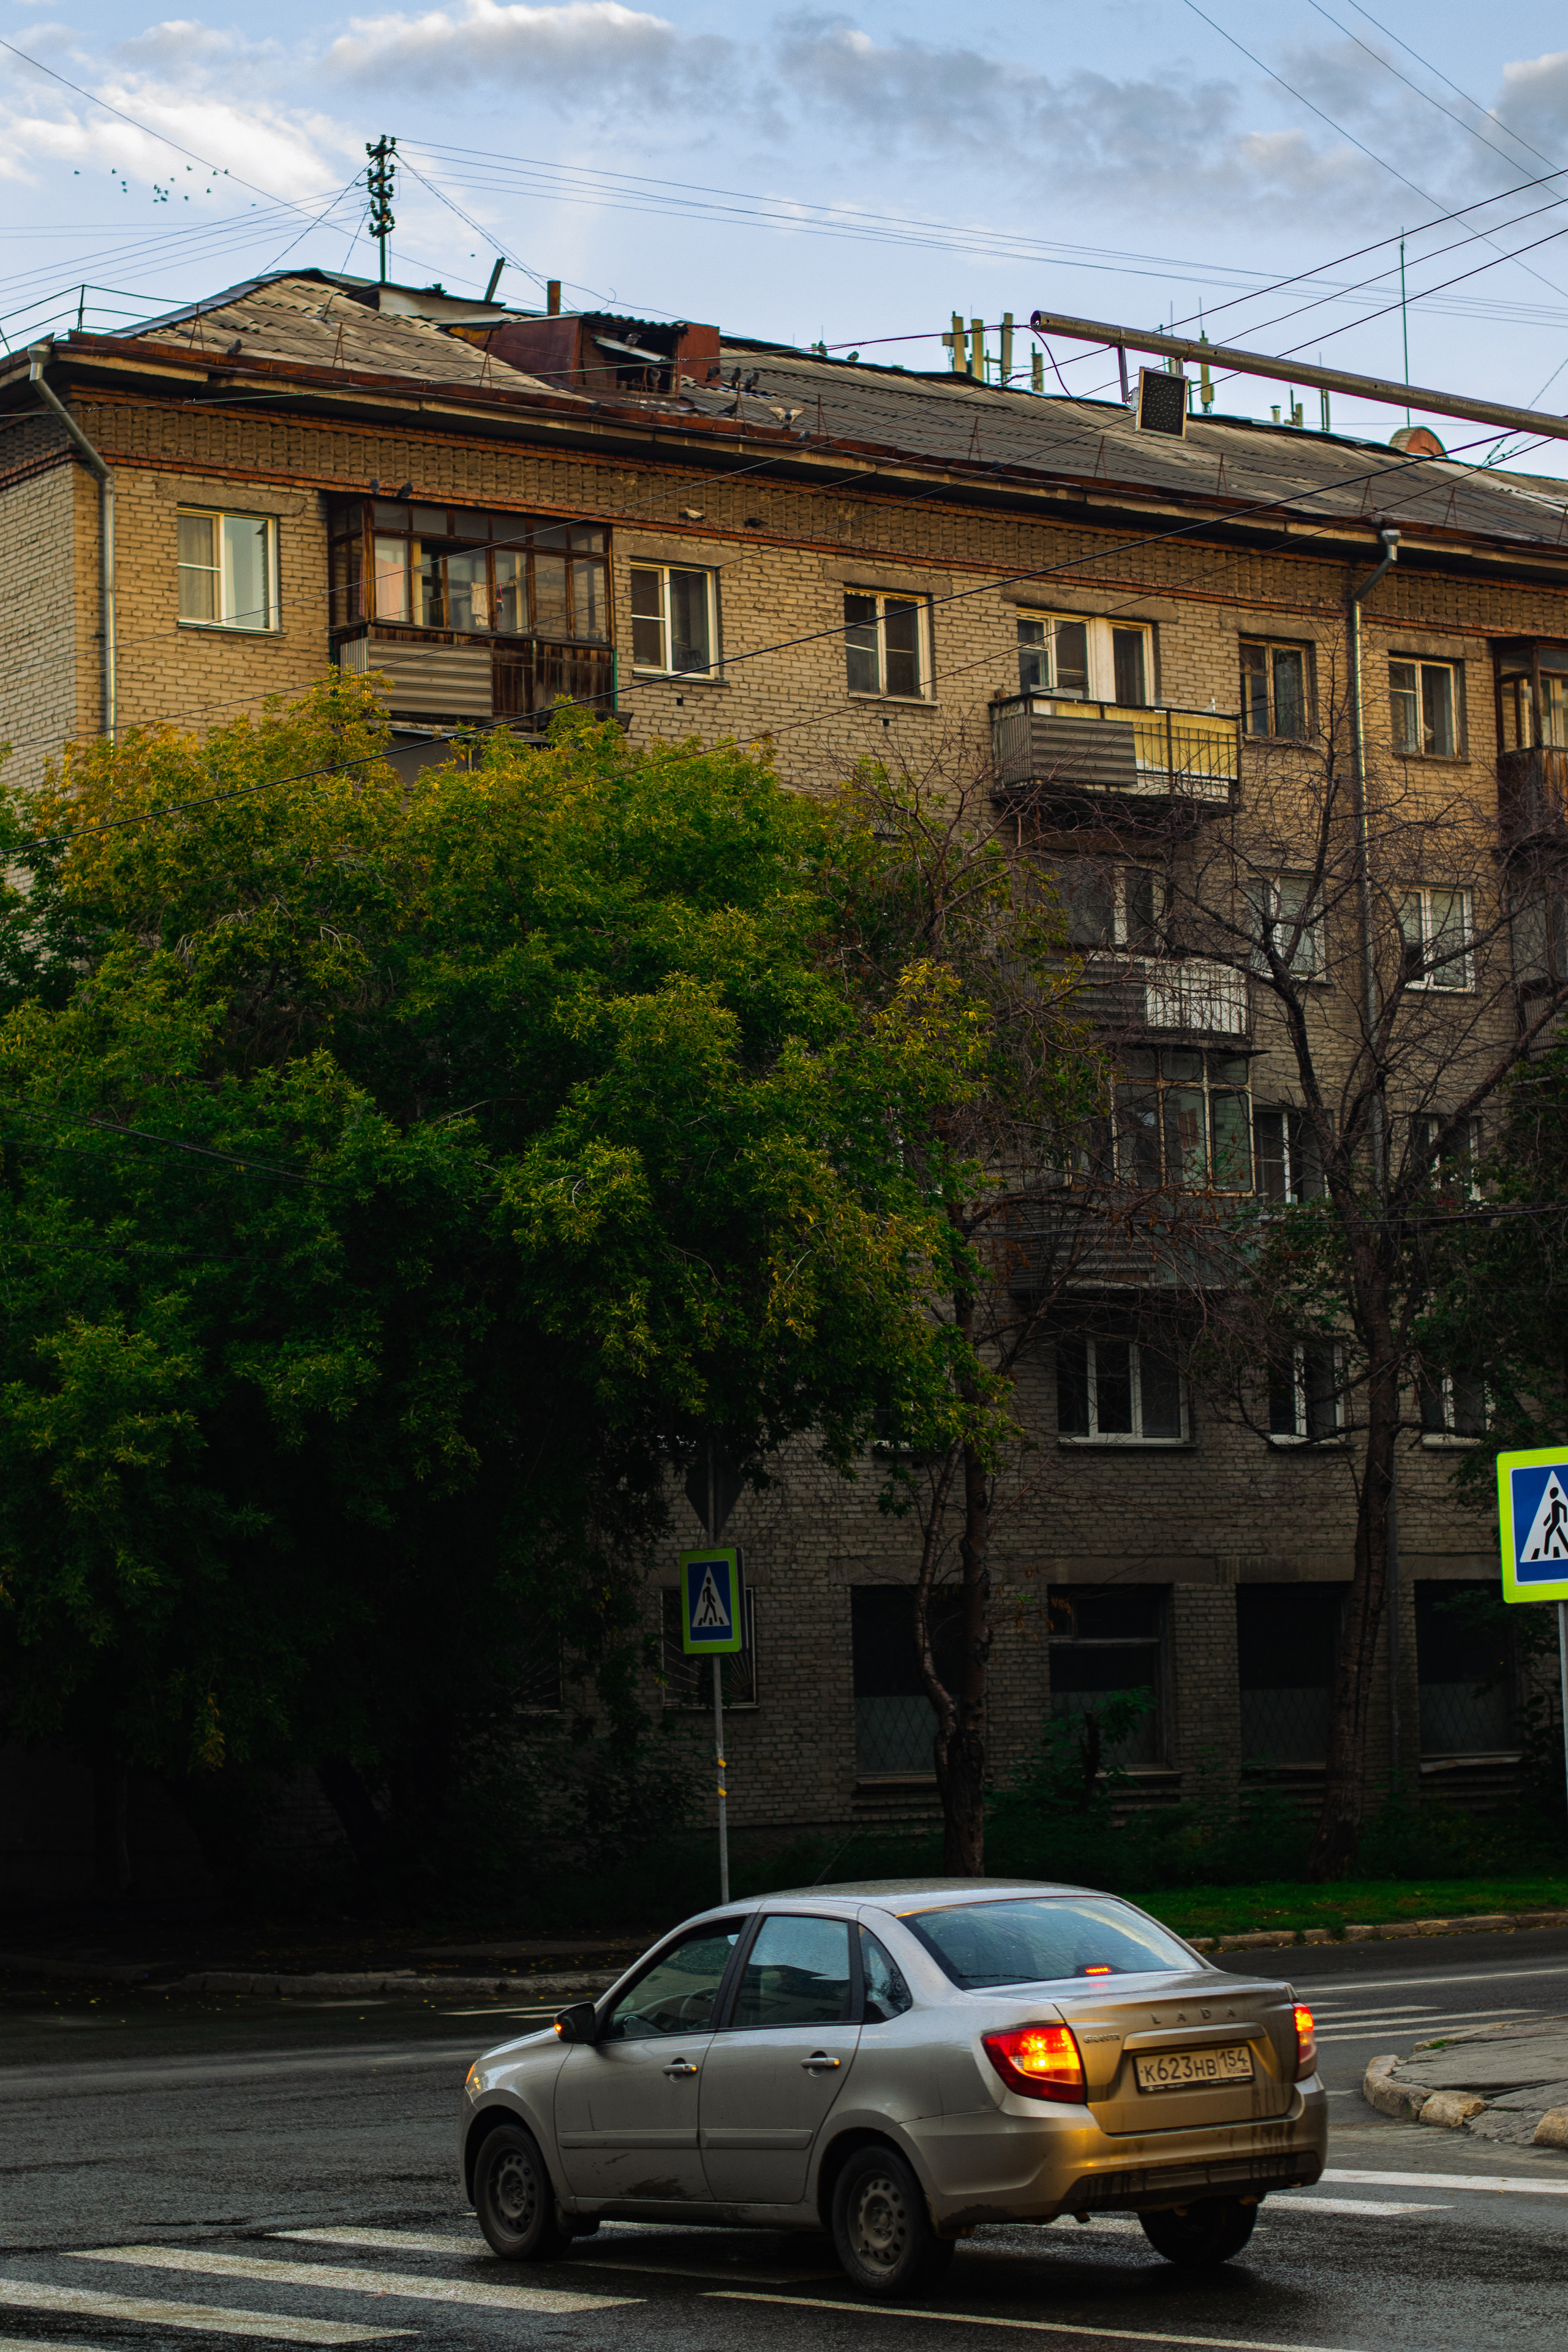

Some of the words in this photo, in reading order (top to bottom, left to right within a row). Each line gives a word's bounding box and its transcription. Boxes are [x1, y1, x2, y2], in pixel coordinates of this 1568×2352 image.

[1151, 2007, 1236, 2024] LADA
[1083, 2034, 1120, 2043] GRANTA
[1219, 2049, 1248, 2068] 154
